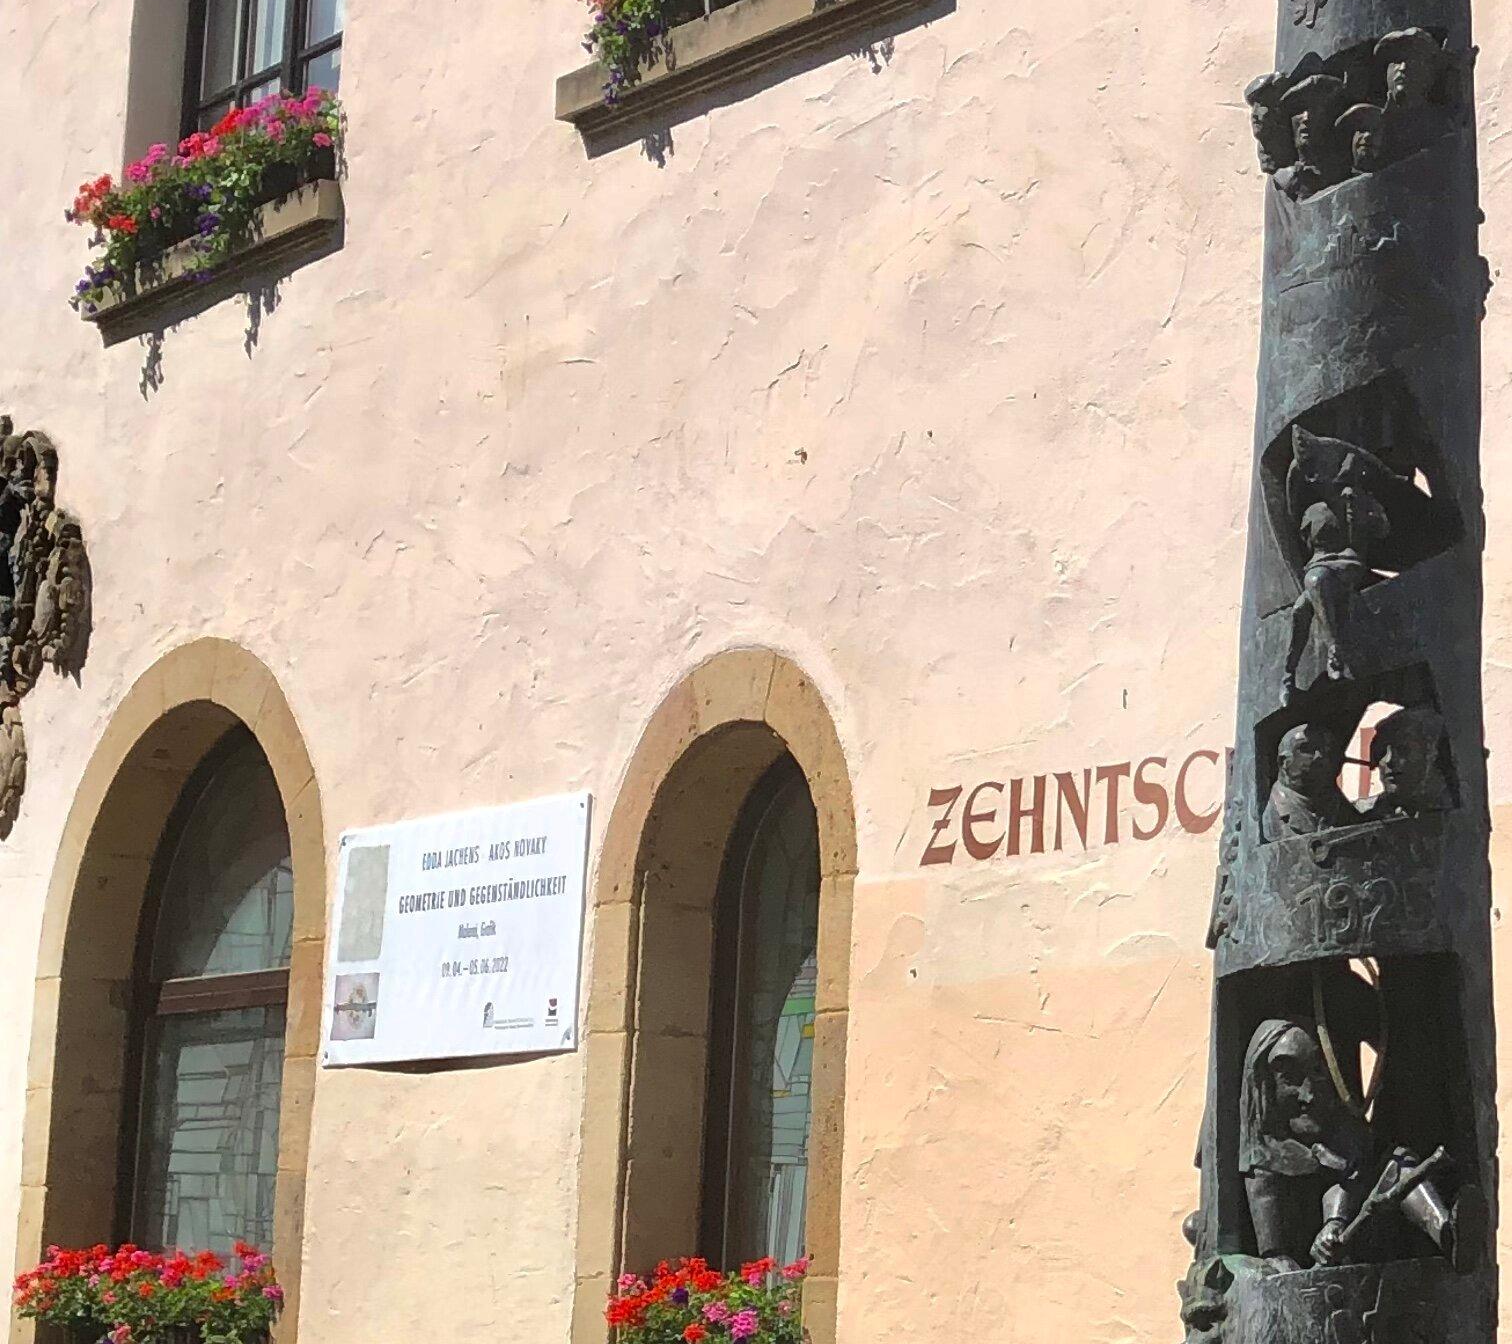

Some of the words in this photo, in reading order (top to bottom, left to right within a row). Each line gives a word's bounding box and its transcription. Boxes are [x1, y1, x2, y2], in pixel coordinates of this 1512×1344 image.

[920, 746, 1234, 866] ZEHNTSC
[422, 852, 441, 871] EDDA
[445, 846, 479, 867] JACHENS
[489, 841, 510, 861] AKOS
[514, 836, 547, 856] NOVAKY
[399, 891, 445, 914] GEOMETRIE
[448, 888, 466, 907] UND
[470, 875, 567, 905] GEGENSTÄNDLICHKEIT
